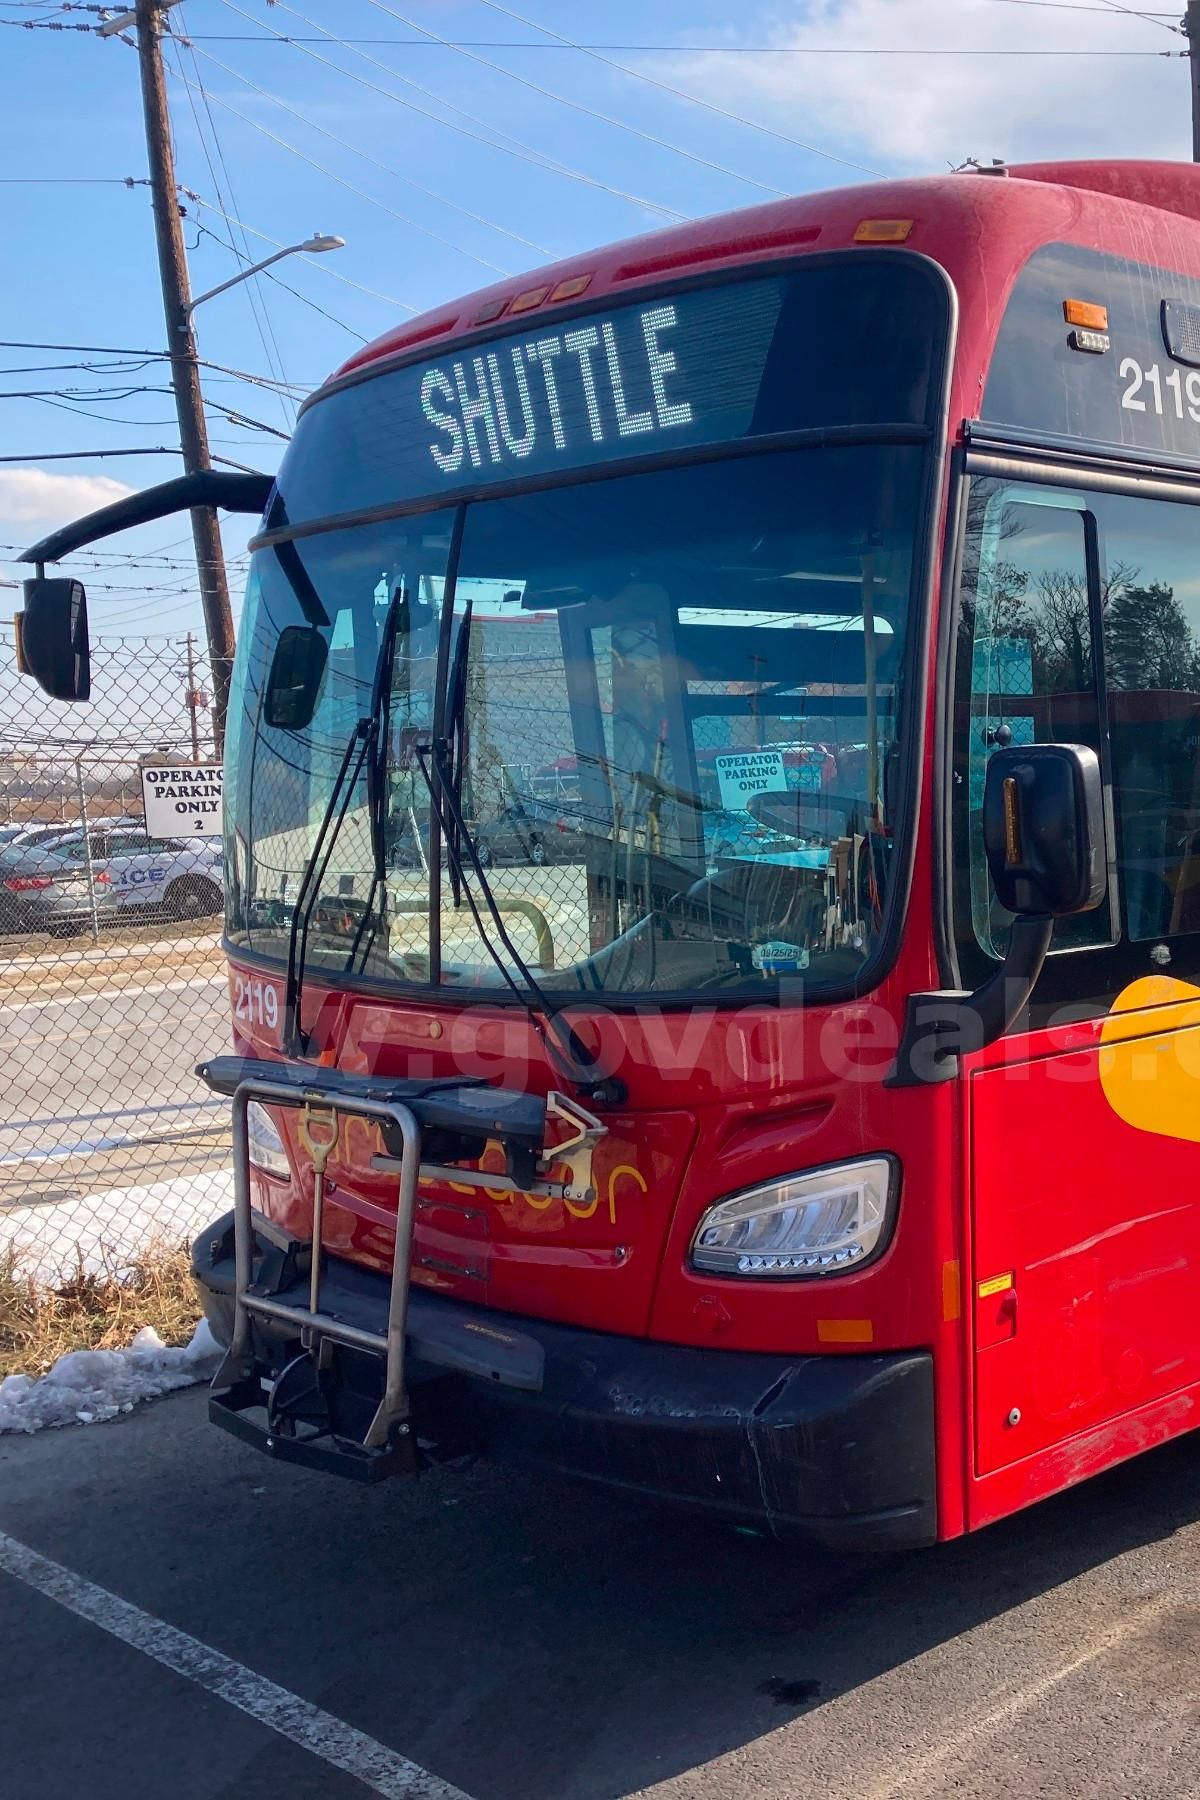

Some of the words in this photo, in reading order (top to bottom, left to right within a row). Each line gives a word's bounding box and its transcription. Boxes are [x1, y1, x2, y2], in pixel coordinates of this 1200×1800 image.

[420, 304, 693, 473] SHUTTLE
[717, 753, 781, 769] OPERATOR
[724, 766, 778, 780] PARKING
[738, 779, 769, 791] ONLY
[175, 801, 220, 813] ONLY
[194, 819, 204, 830] 2
[111, 867, 166, 885] ICE
[234, 976, 278, 1029] 2119
